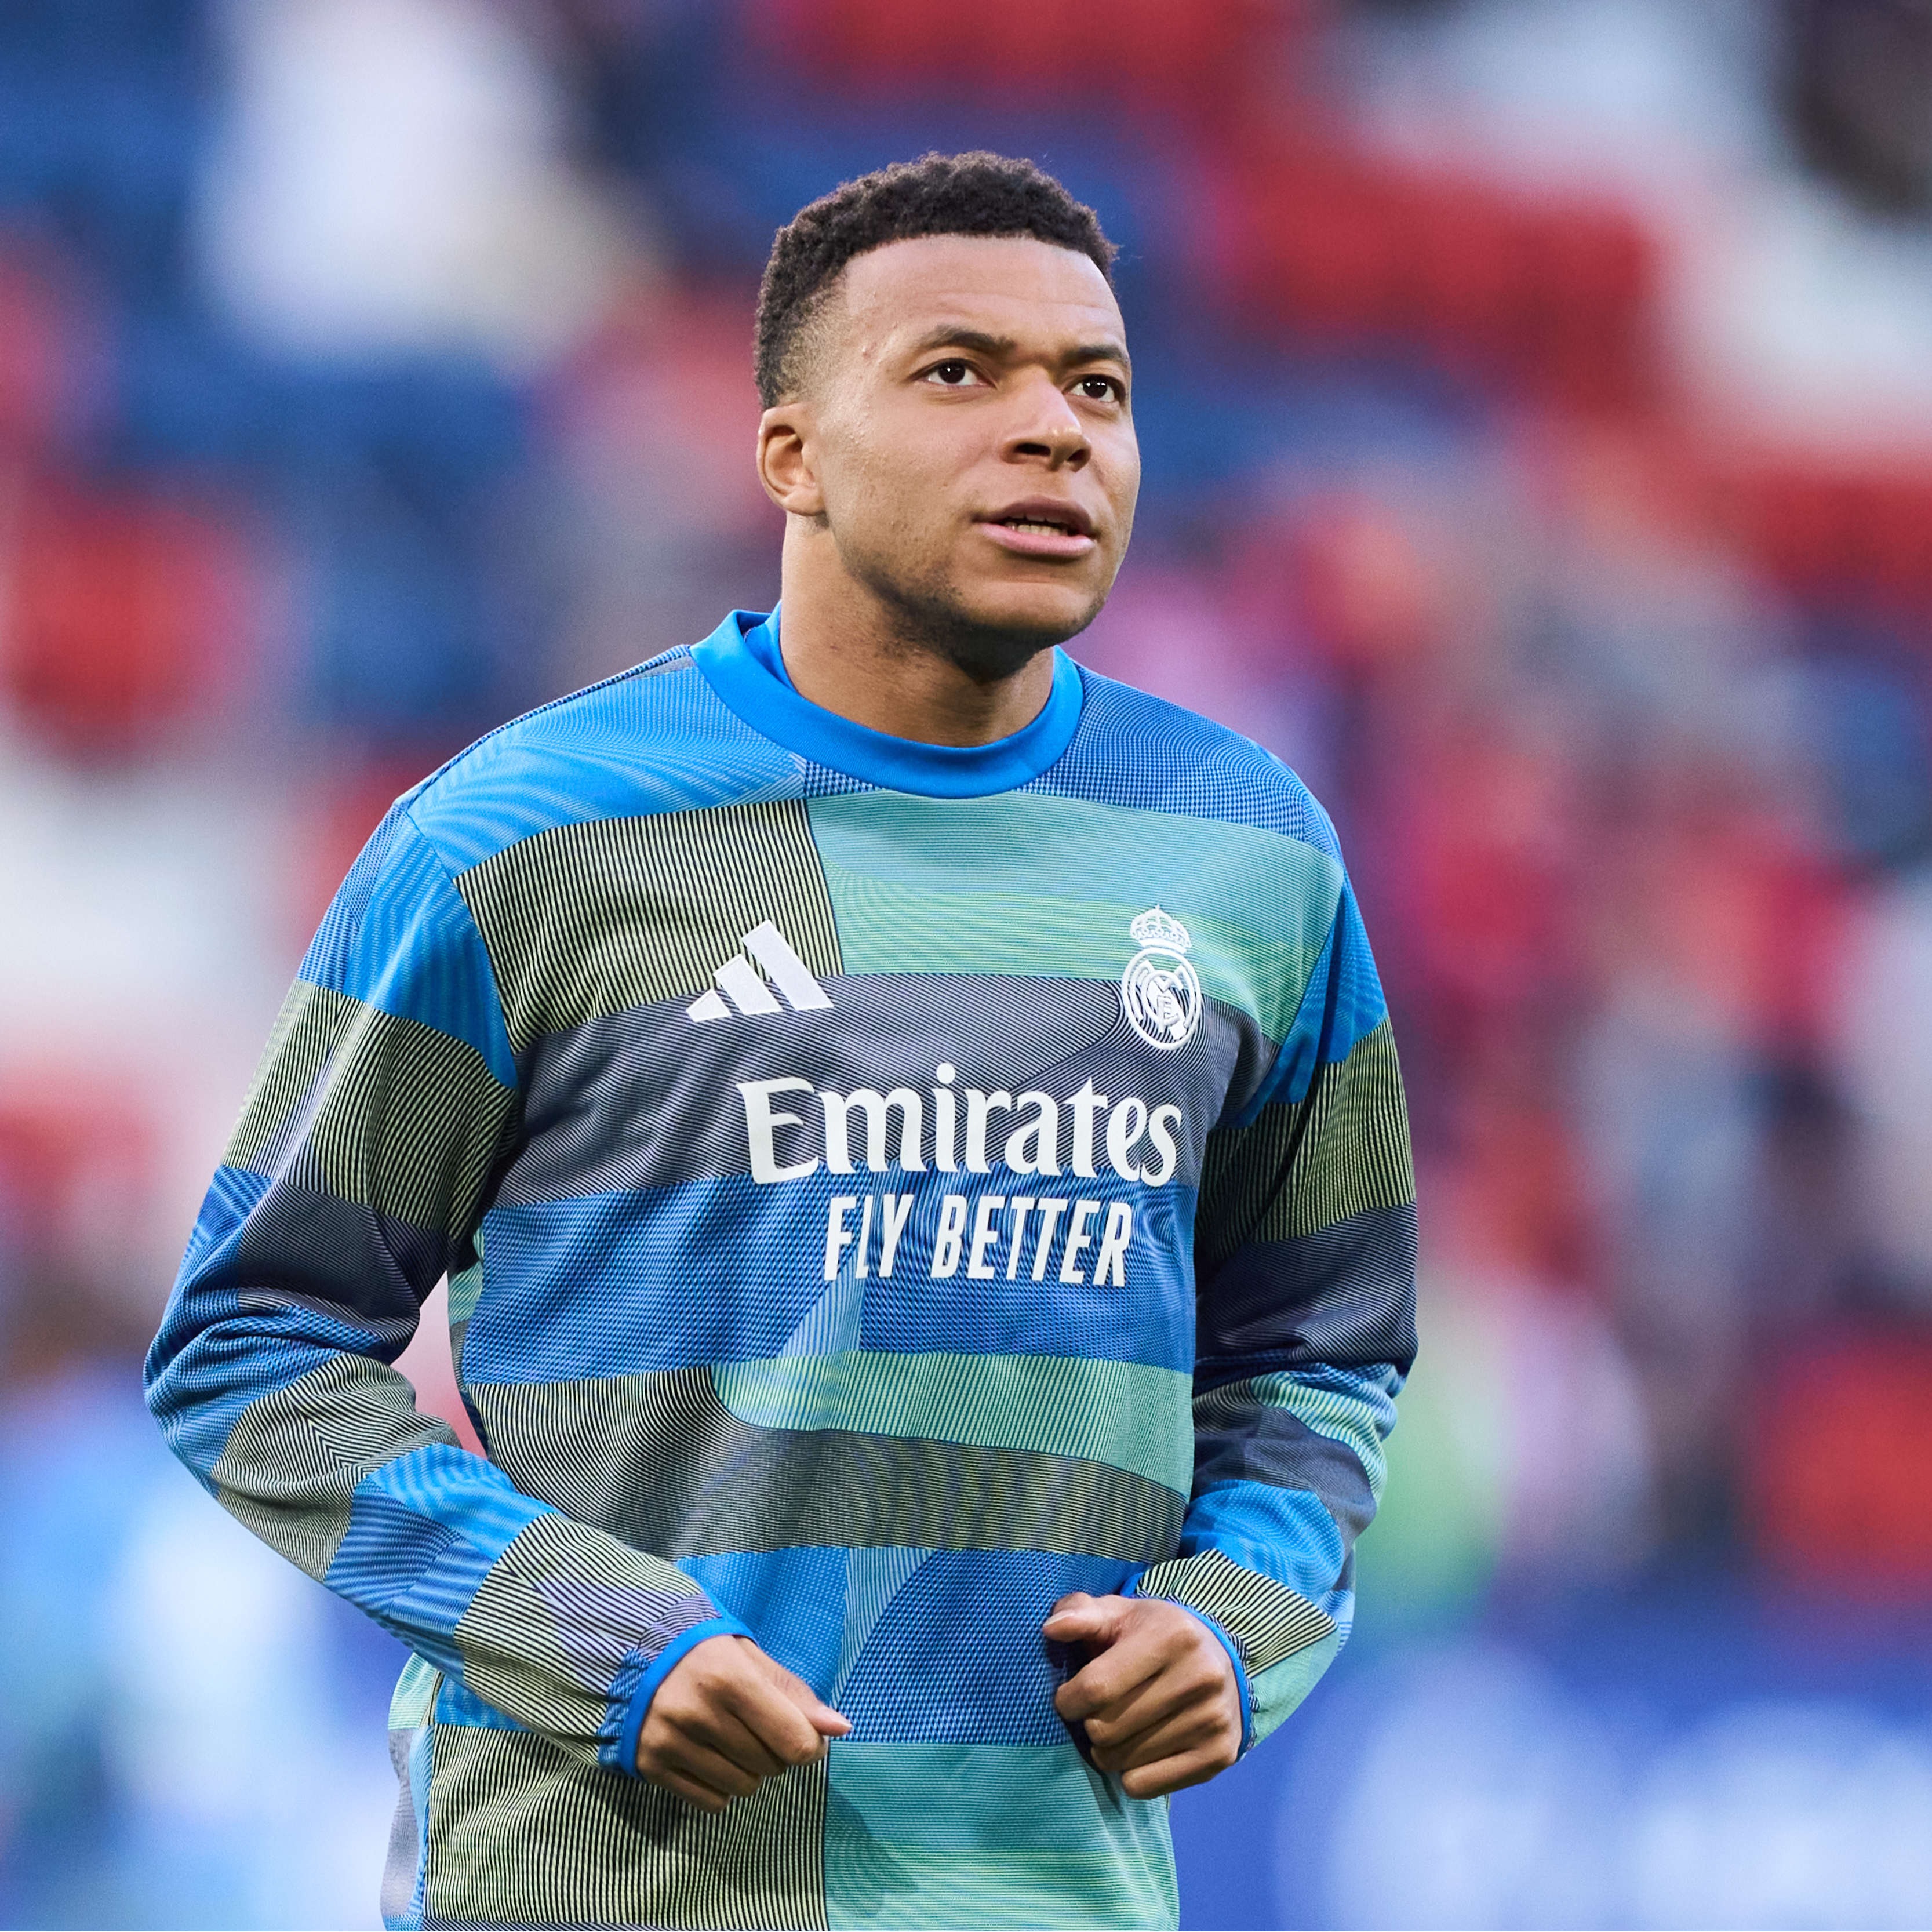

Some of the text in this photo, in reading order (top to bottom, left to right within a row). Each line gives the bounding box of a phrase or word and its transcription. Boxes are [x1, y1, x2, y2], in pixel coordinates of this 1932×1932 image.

[737, 1063, 1182, 1186] Emirates
[825, 1194, 1131, 1286] FLY BETTER
